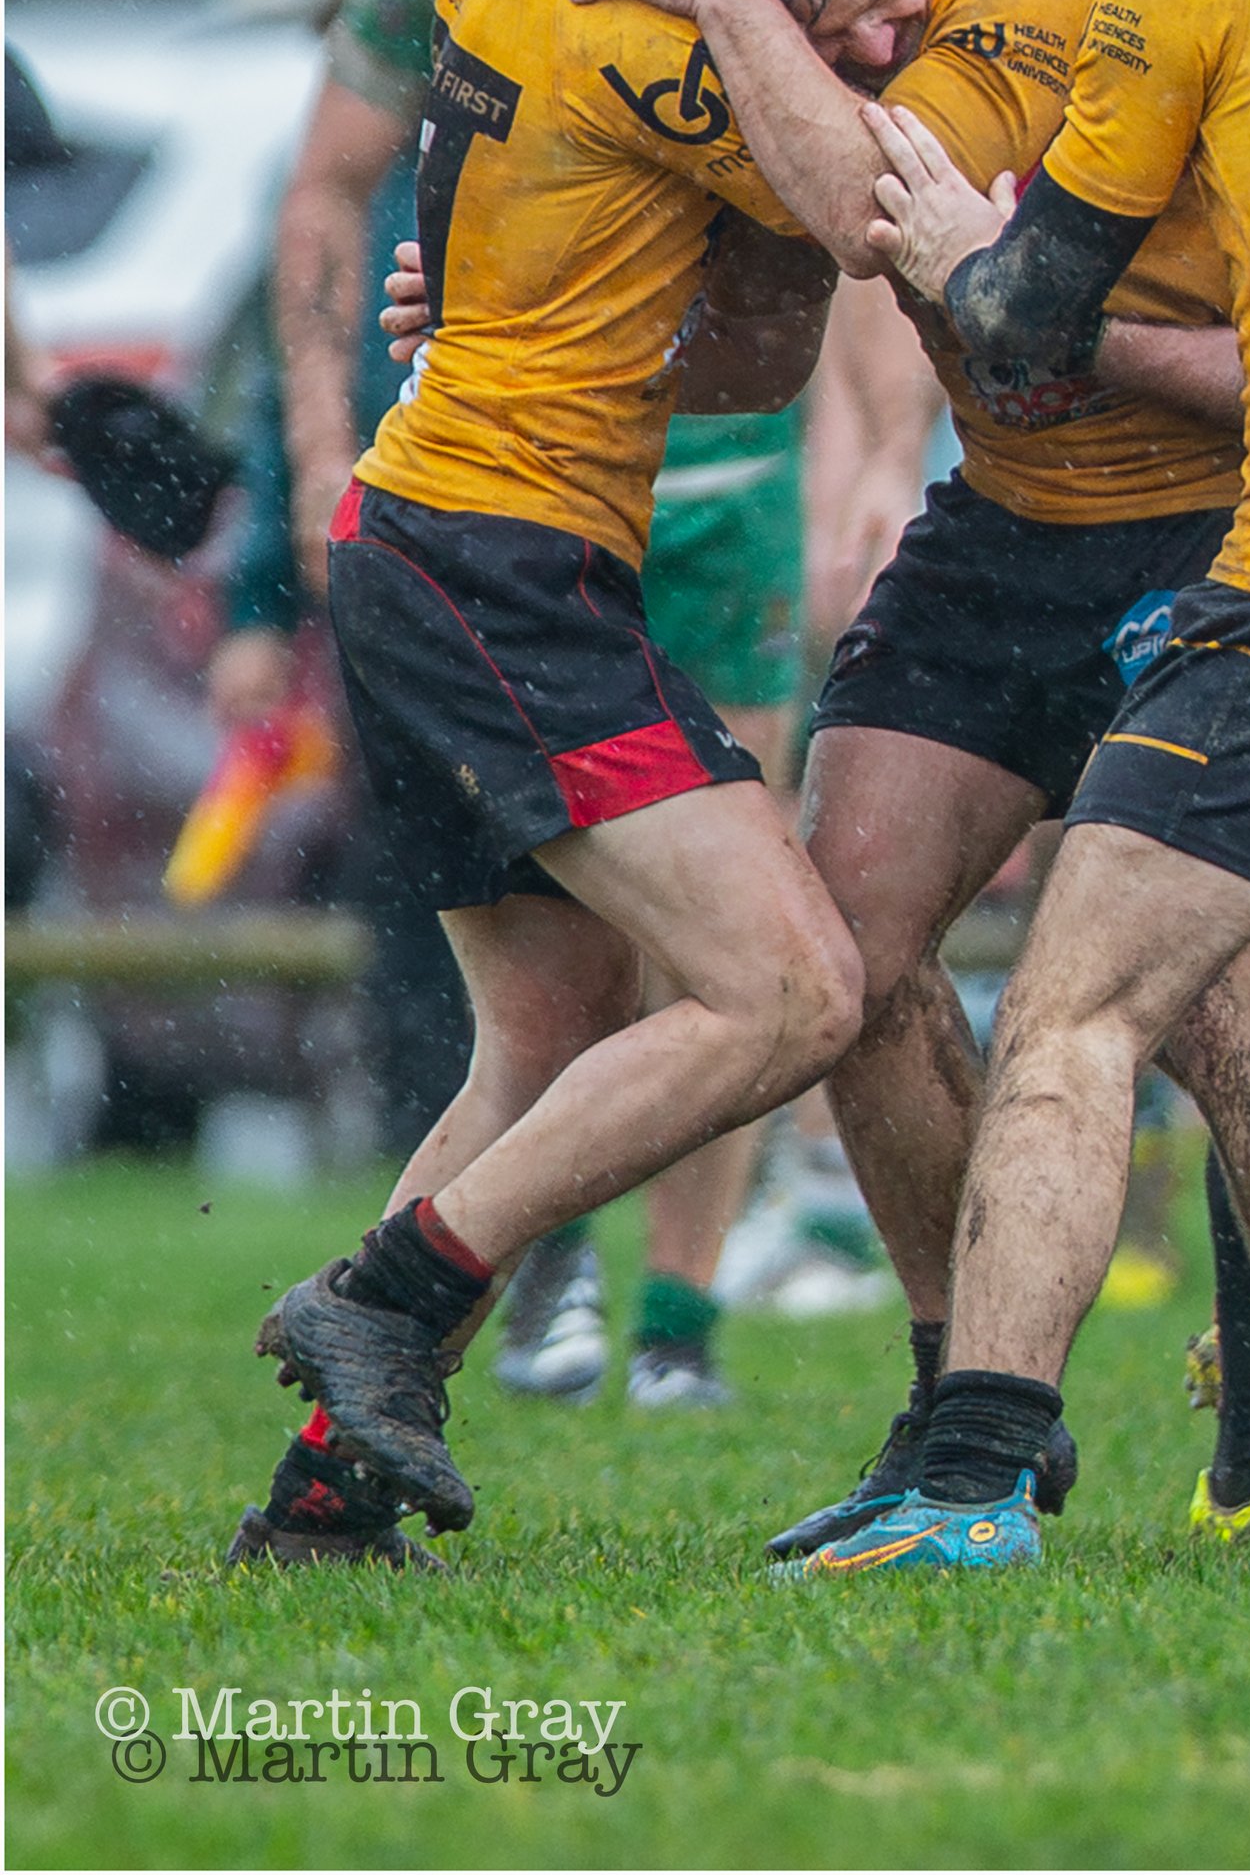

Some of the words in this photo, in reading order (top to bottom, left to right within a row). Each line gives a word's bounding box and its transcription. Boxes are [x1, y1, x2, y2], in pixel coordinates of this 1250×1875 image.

[1014, 23, 1067, 51] HEALTH
[1012, 41, 1070, 77] SCIENCES
[440, 70, 508, 123] FIRST
